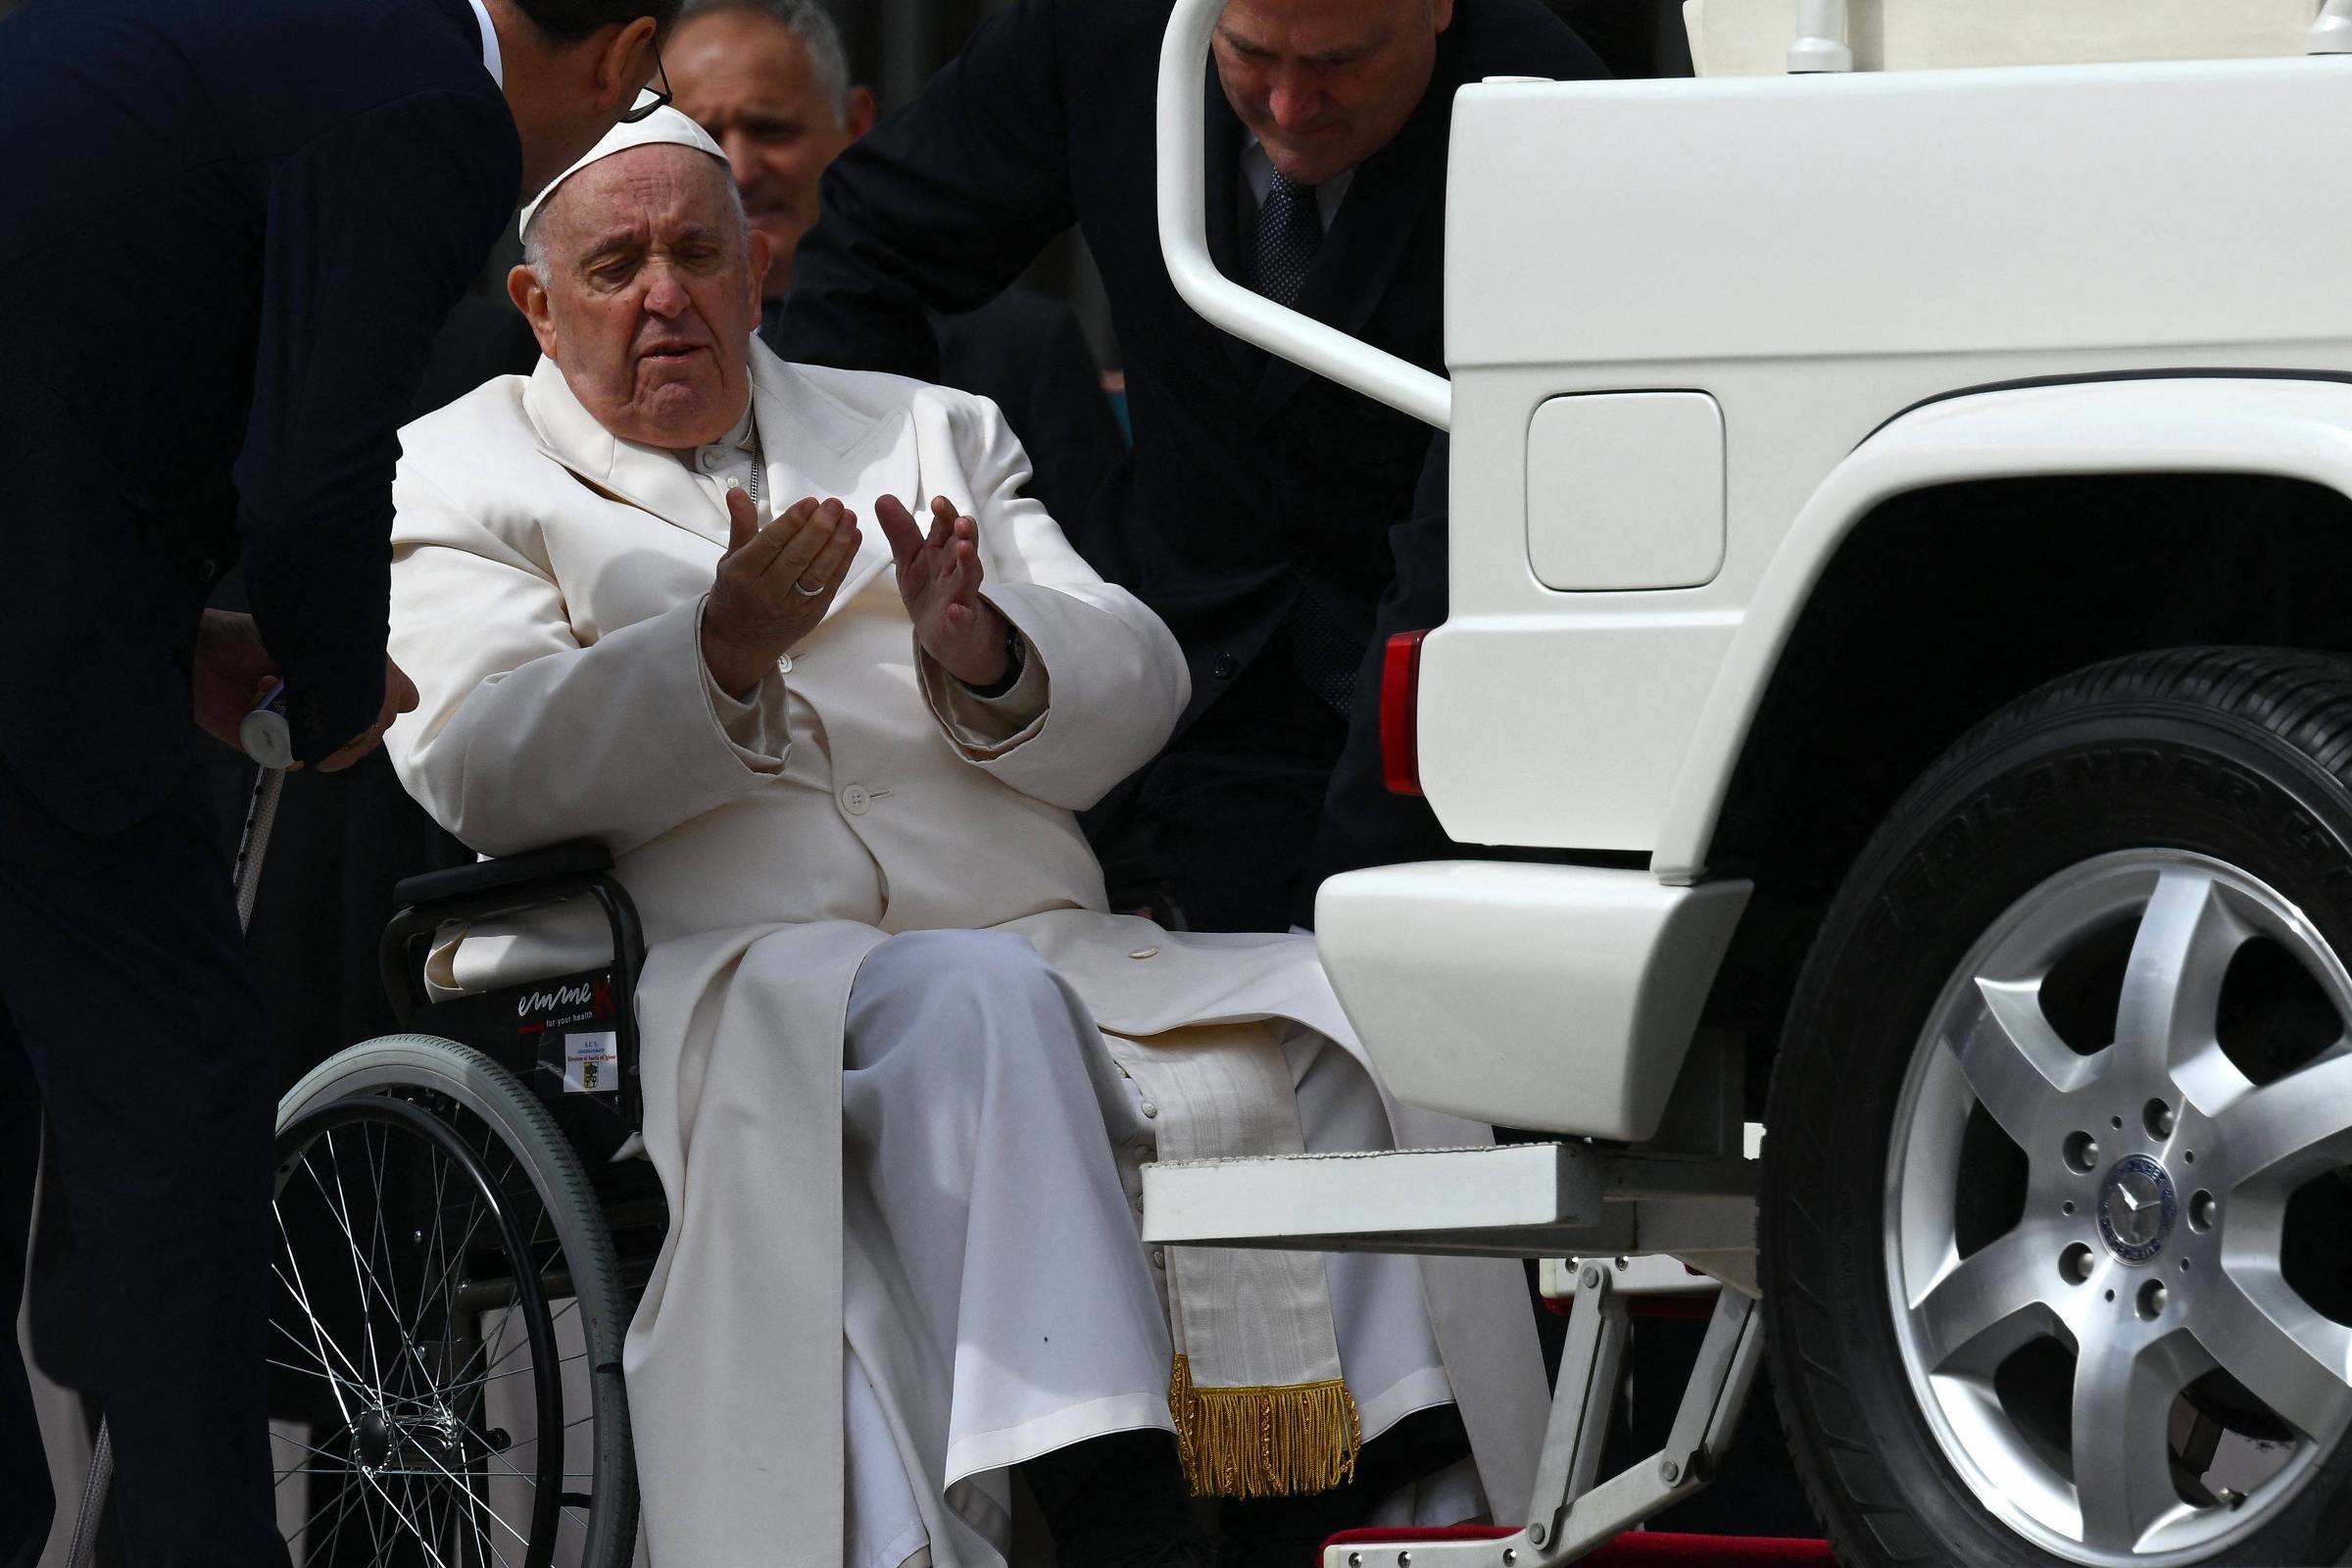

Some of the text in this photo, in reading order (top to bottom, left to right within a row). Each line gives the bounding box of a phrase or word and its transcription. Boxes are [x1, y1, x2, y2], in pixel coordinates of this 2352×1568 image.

[517, 982, 592, 1017] emme
[546, 1011, 594, 1028] for your health
